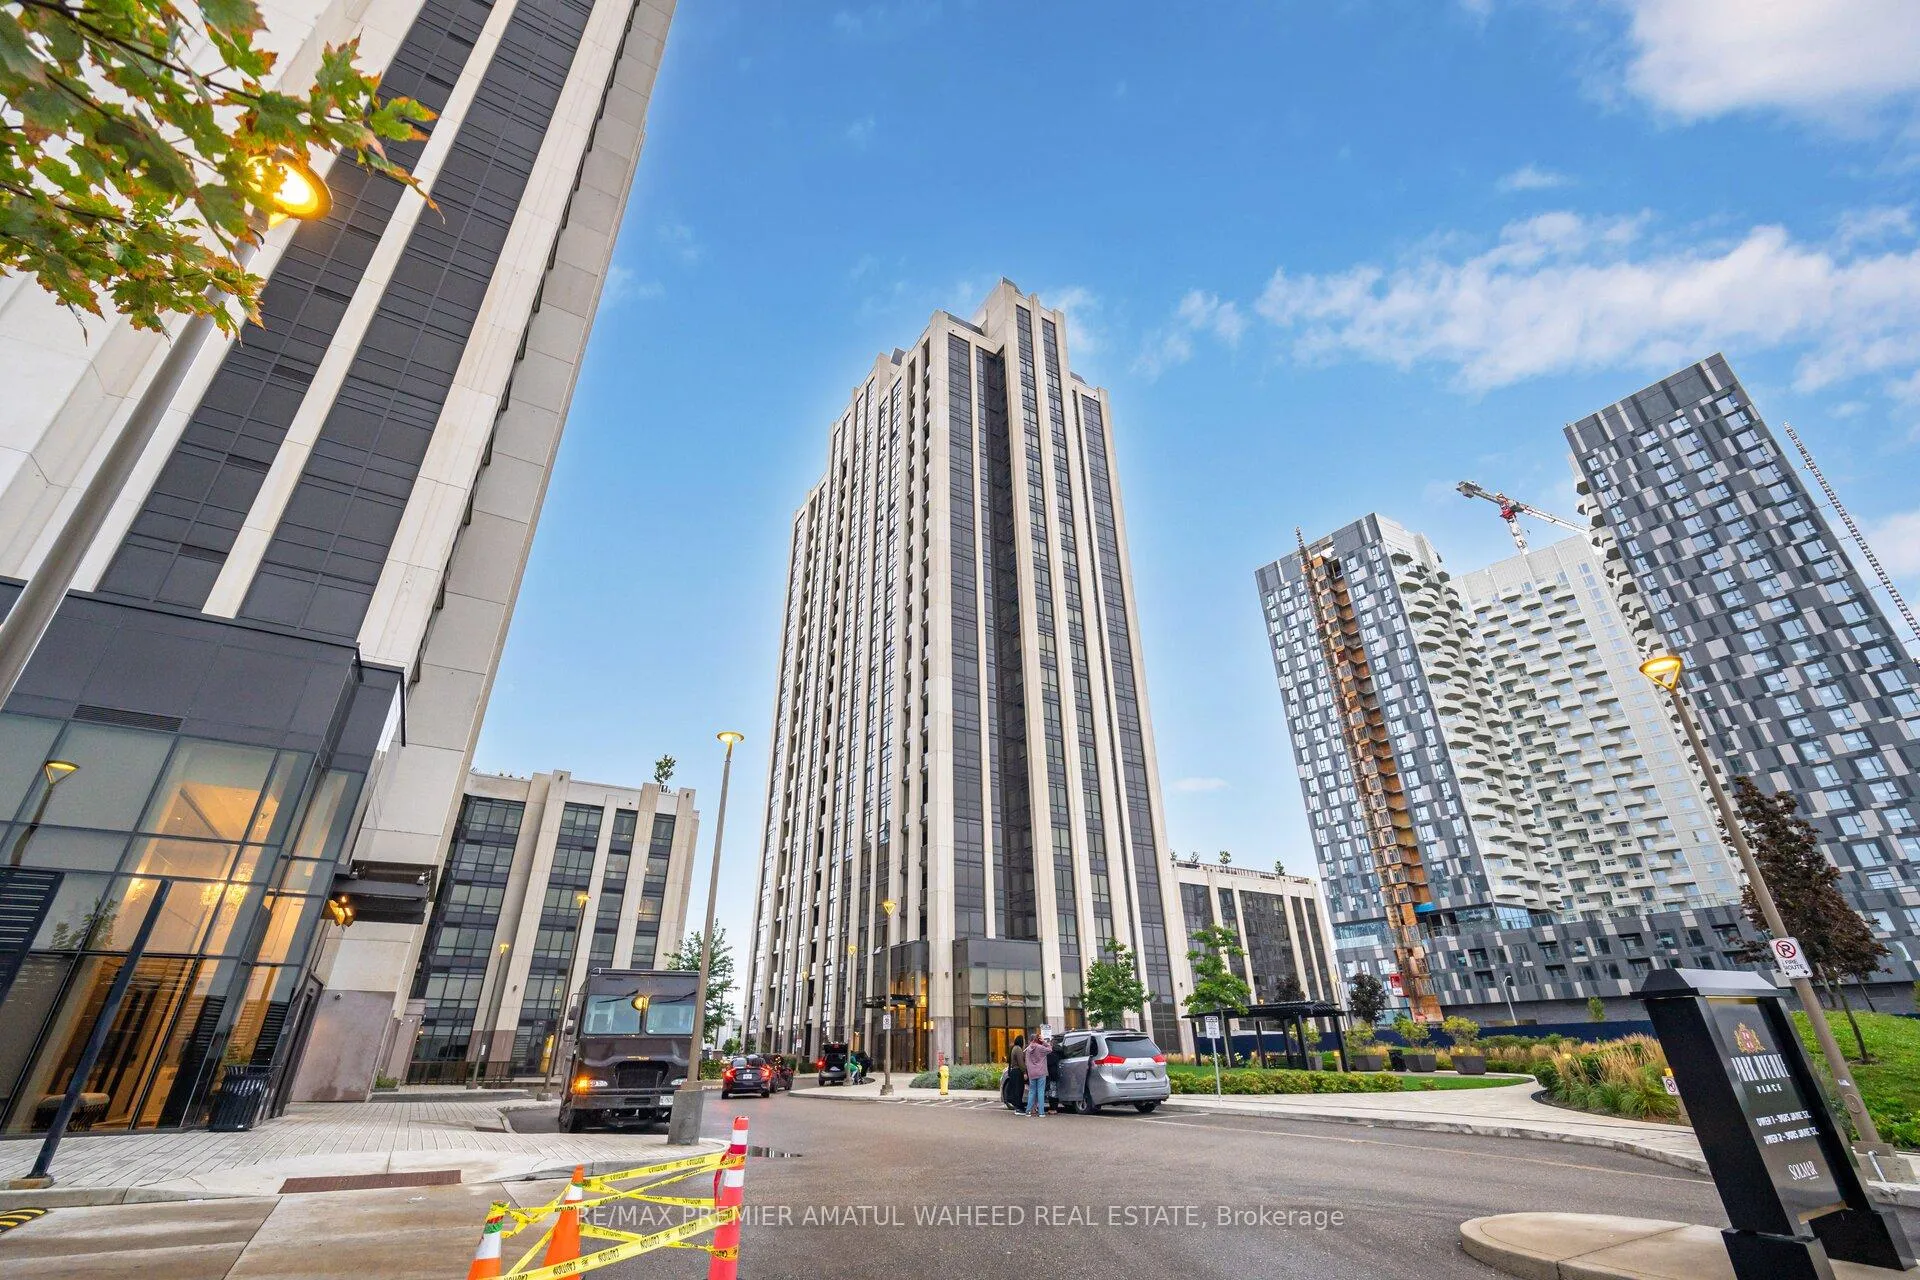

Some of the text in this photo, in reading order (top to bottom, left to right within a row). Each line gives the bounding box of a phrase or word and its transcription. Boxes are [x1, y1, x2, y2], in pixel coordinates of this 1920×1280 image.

[1756, 1083, 1782, 1094] PLACE
[1788, 1160, 1818, 1180] SOLMAR
[640, 1235, 660, 1250] CAUTION
[598, 1248, 619, 1263] CAUTION
[553, 1261, 576, 1276] CAUTION
